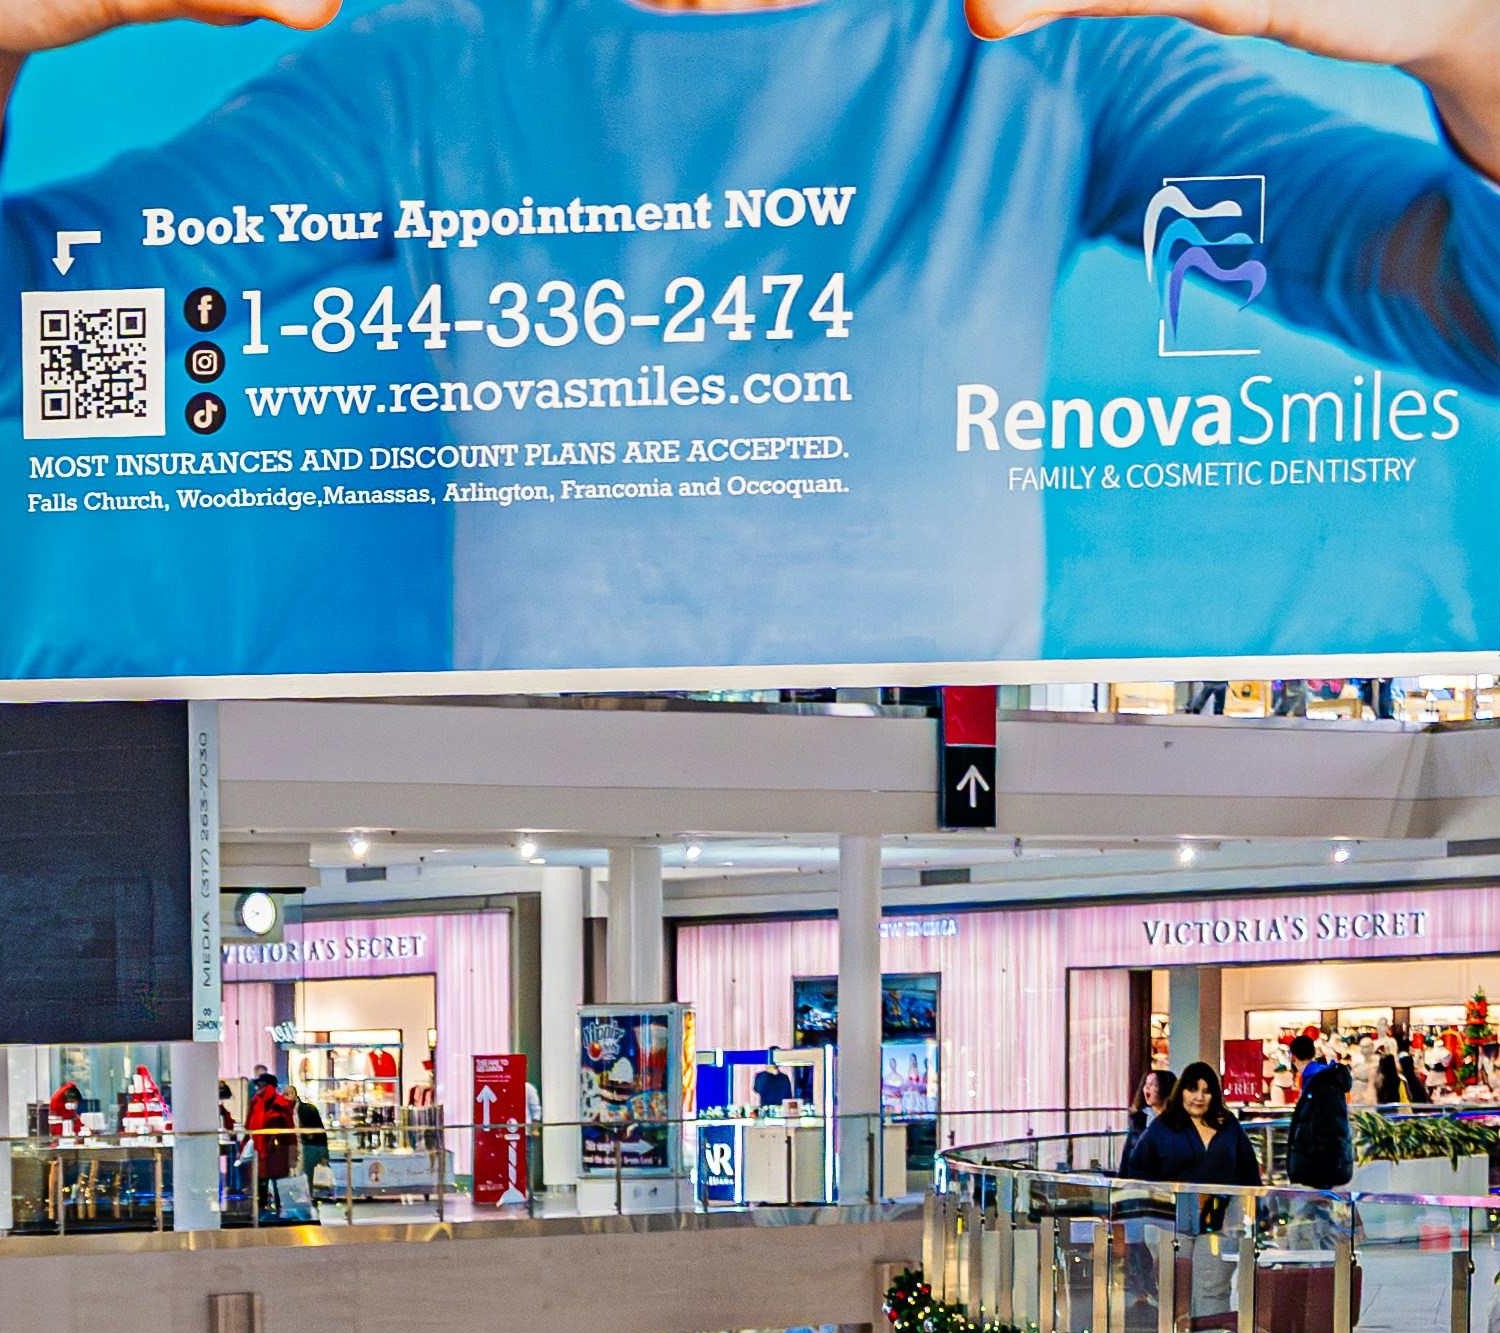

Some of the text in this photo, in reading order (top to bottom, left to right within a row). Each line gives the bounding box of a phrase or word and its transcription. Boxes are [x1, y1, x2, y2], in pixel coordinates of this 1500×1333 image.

[143, 187, 857, 248] Book Your Appointment NOW
[242, 273, 853, 354] 1-844-336-2474
[245, 365, 852, 417] www.renovasmiles.com
[956, 370, 1460, 452] RenovaSmiles
[29, 436, 849, 478] MOST INSURANCES AND DISCOUNT PLANS ARE ACCEPTED.
[1009, 457, 1416, 490] FAMILY & COSMETIC DENTISTRY
[28, 493, 78, 512] Falls
[85, 490, 172, 512] Church,
[444, 482, 555, 507] Arlington,
[561, 479, 674, 500] Franconia
[679, 477, 722, 497] and
[727, 475, 850, 500] Occoquan.
[199, 732, 211, 987] MEDIA (317) 263-7030
[1142, 909, 1429, 947] VICTORIA'S SECRET
[222, 935, 426, 966] VICTORIA'S SECRET
[196, 1020, 219, 1031] SIMON
